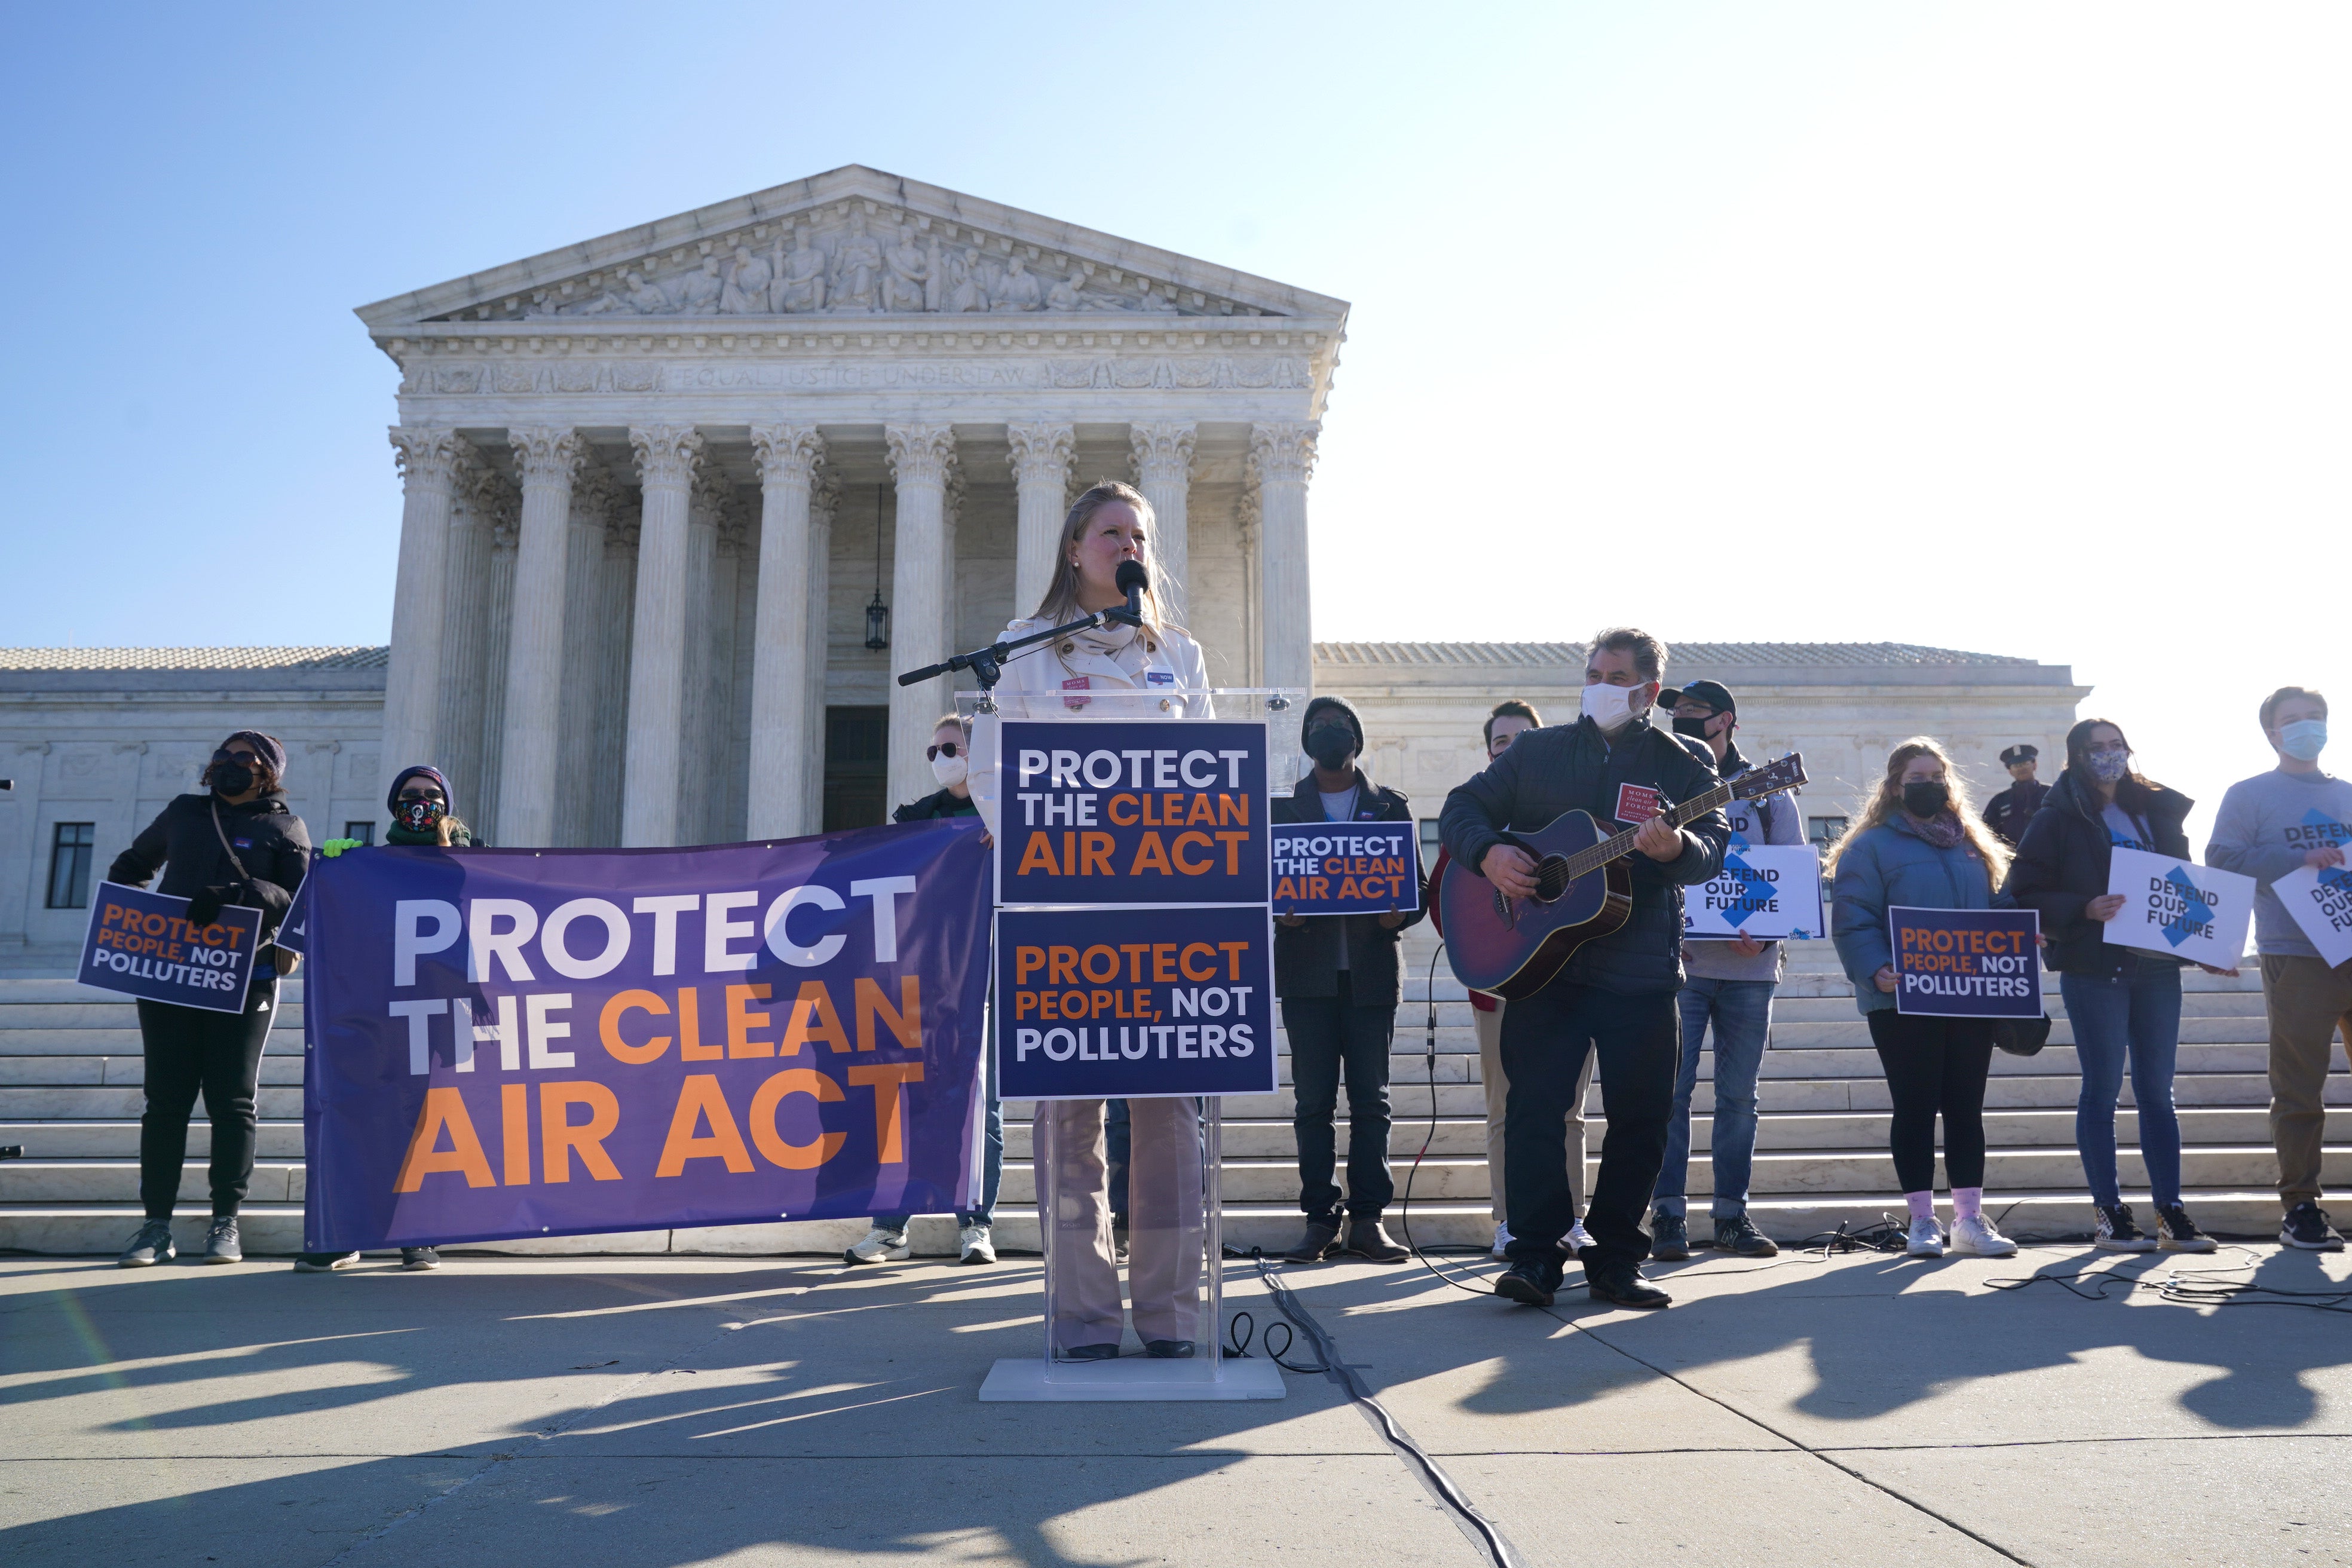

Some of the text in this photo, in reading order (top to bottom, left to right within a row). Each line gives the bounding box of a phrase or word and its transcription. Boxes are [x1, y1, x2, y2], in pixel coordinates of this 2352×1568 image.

[682, 366, 1025, 386] EQUAL JUSTICE UNDER LAW
[1019, 749, 1248, 789] PROTECT
[1628, 790, 1653, 798] MOMS
[1017, 793, 1250, 826] THE CLEAN
[1274, 836, 1403, 857] PROTECT
[2284, 823, 2352, 842] DEFEN
[1016, 831, 1250, 876] AIR ACT
[1273, 858, 1404, 875] THE CLEAN
[1273, 875, 1405, 900] AIR ACT
[1705, 882, 1746, 896] OUR
[1719, 868, 1780, 882] EFEND
[2310, 870, 2352, 904] DEFE
[1706, 897, 1779, 912] FUTURE
[2148, 894, 2188, 915] OUR
[2150, 877, 2219, 906] DEFEND
[102, 903, 245, 949] PROTECT
[395, 875, 916, 986] PROTECT
[2147, 909, 2214, 939] FUTURE
[97, 927, 242, 969] PEOPLE, NOT
[1900, 927, 2025, 954] PROTECT
[92, 948, 237, 991] POLLUTERS
[1016, 941, 1249, 985] PROTECT
[1903, 953, 2028, 976] PEOPLE, NOT
[1904, 973, 2030, 997] POLLUTERS
[1015, 986, 1253, 1022] PEOPLE, NOT
[390, 975, 922, 1074] THE CLEAN
[1016, 1024, 1254, 1062] POLLUTERS
[393, 1062, 924, 1193] AIR ACT
